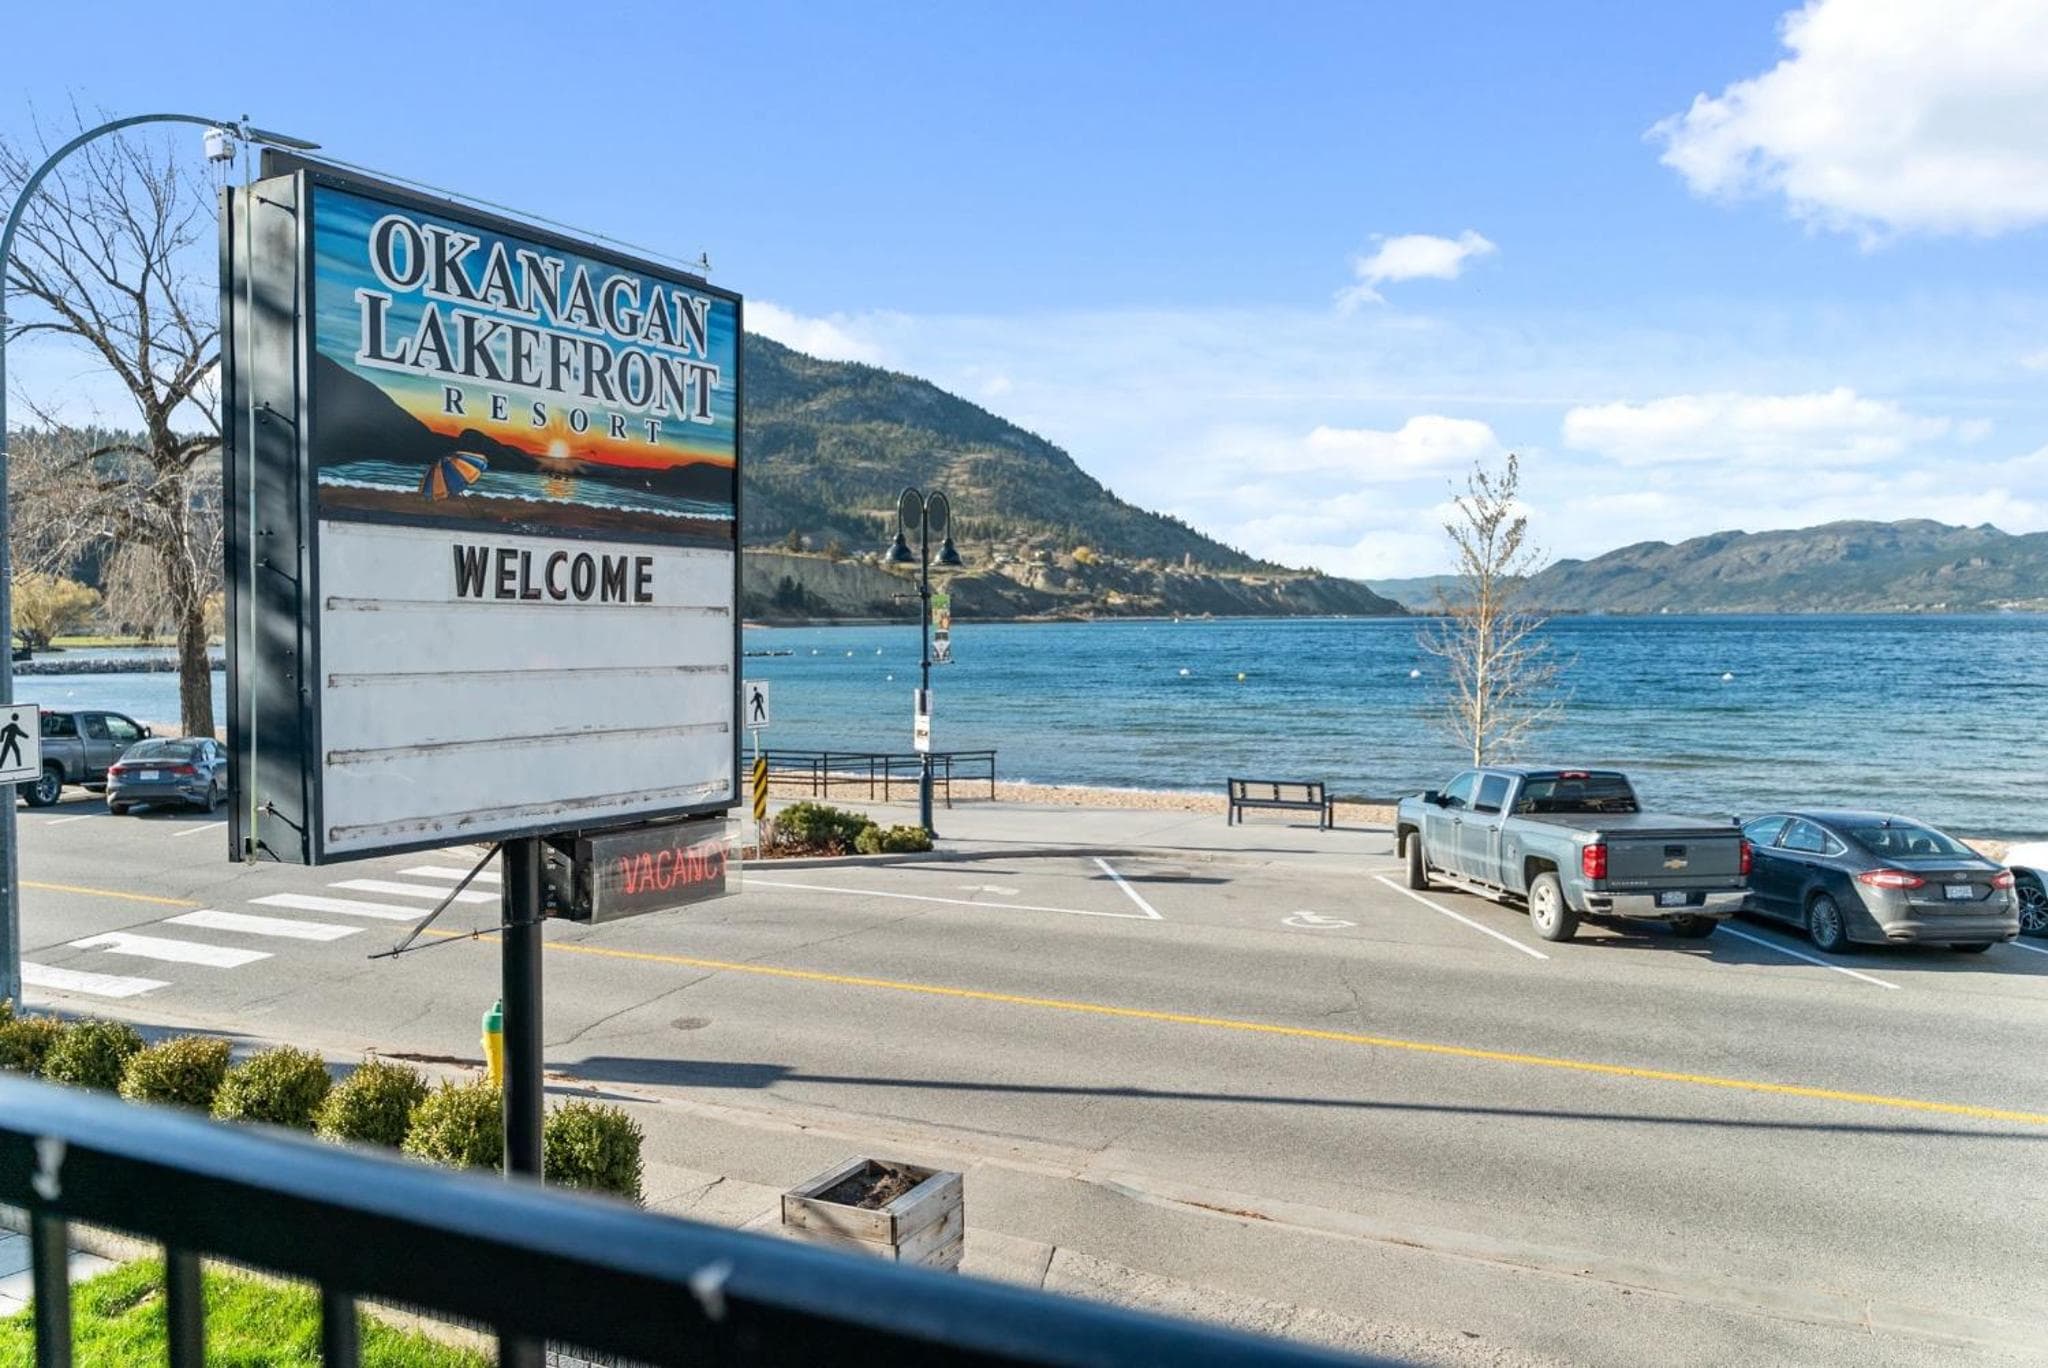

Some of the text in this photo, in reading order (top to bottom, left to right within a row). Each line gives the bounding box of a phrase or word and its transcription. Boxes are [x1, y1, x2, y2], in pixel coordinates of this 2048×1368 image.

[371, 216, 709, 356] OKANAGAN
[358, 290, 718, 421] LAKEFRONT
[444, 388, 661, 444] RESORT
[453, 545, 653, 603] WELCOME
[620, 840, 731, 894] VACANCY
